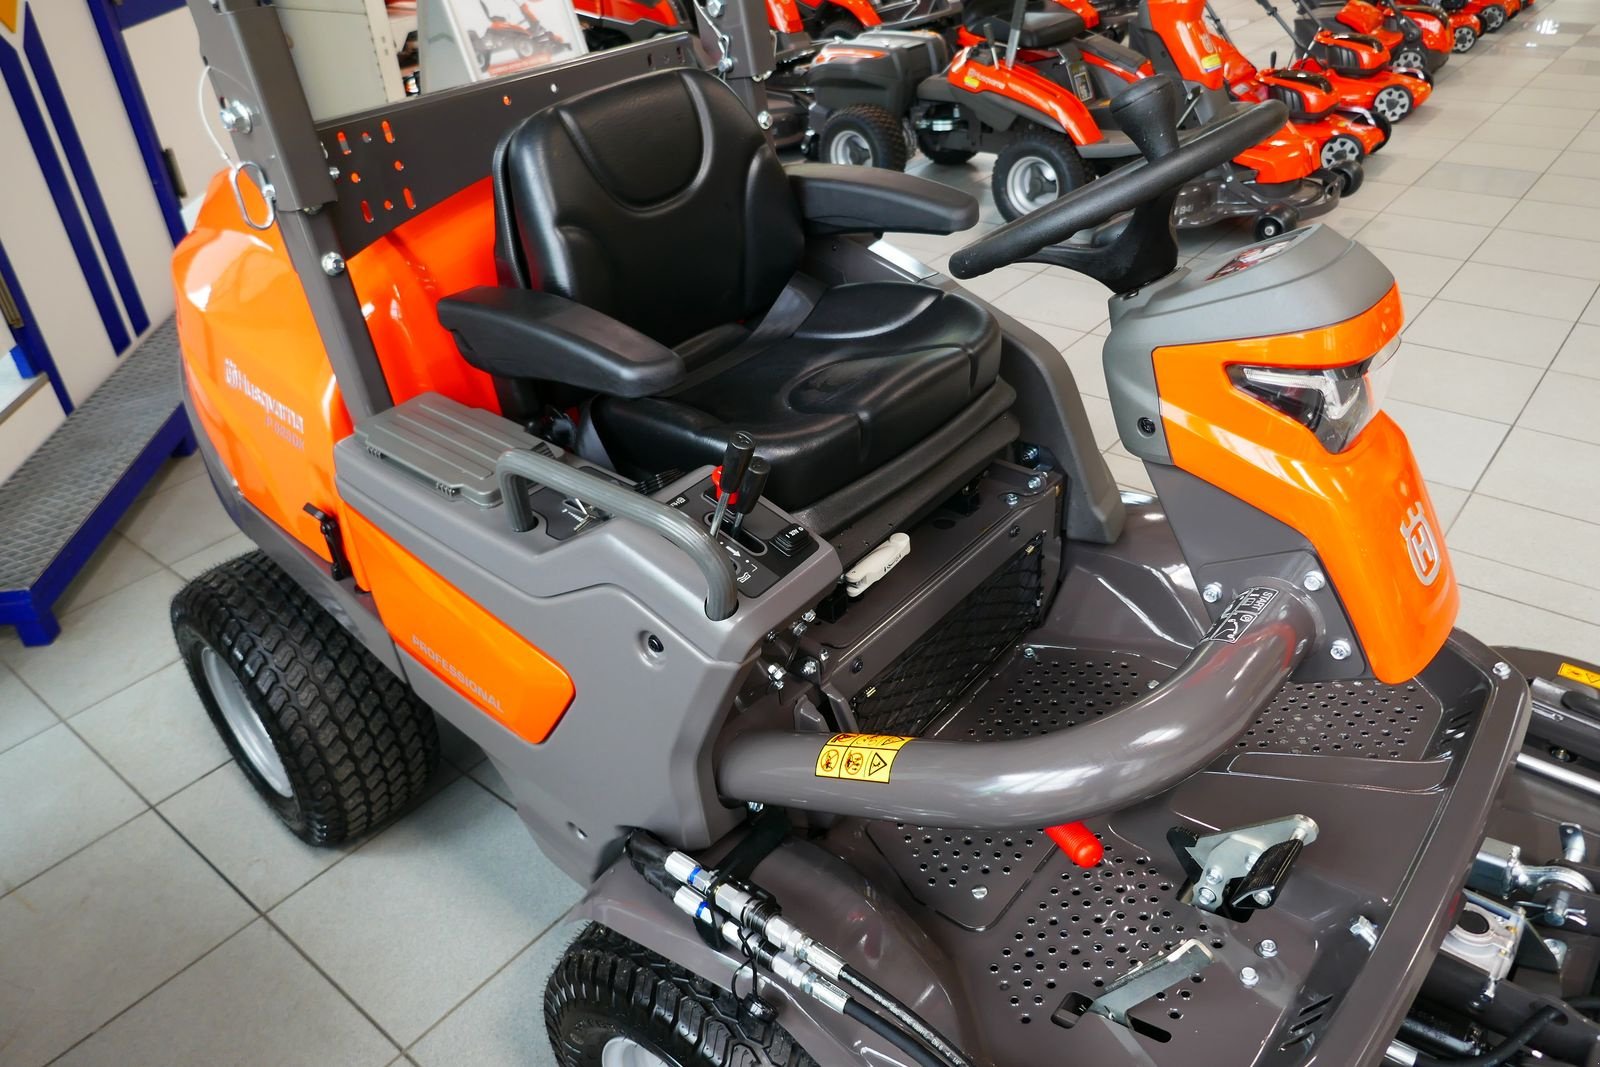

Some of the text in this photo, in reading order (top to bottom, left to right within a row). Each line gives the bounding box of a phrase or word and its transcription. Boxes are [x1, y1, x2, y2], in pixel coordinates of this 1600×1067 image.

[237, 366, 304, 434] Husqvarna
[1252, 591, 1273, 612] START
[412, 633, 504, 714] PROFESSIONAL
